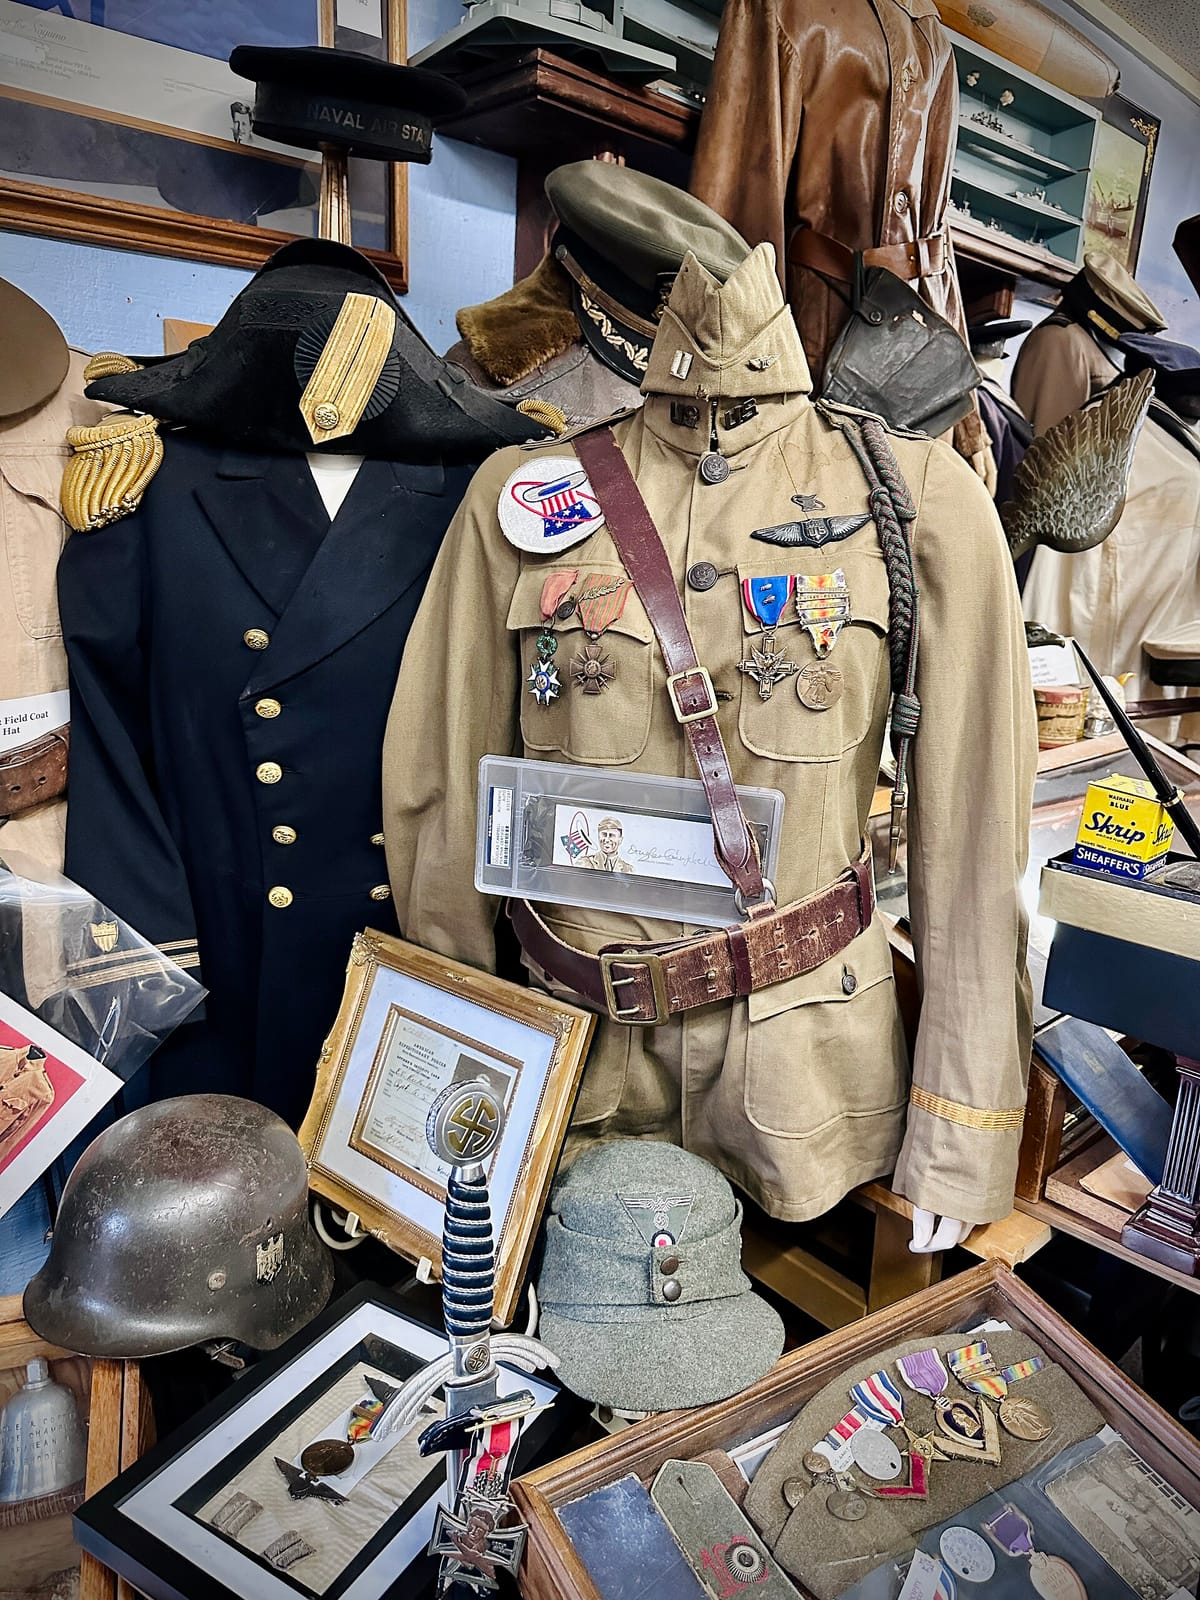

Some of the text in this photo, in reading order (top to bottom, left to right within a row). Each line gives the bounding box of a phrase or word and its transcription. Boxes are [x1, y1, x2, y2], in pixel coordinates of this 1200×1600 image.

[306, 103, 365, 130] NAVAL
[370, 118, 398, 134] AIR
[4, 710, 49, 725] Field Coat
[3, 726, 20, 736] Hat
[1108, 793, 1135, 804] WASHABLE
[1109, 801, 1130, 811] BLUE
[1084, 812, 1146, 845] Skrip
[1076, 847, 1141, 877] SHEAFFER'S
